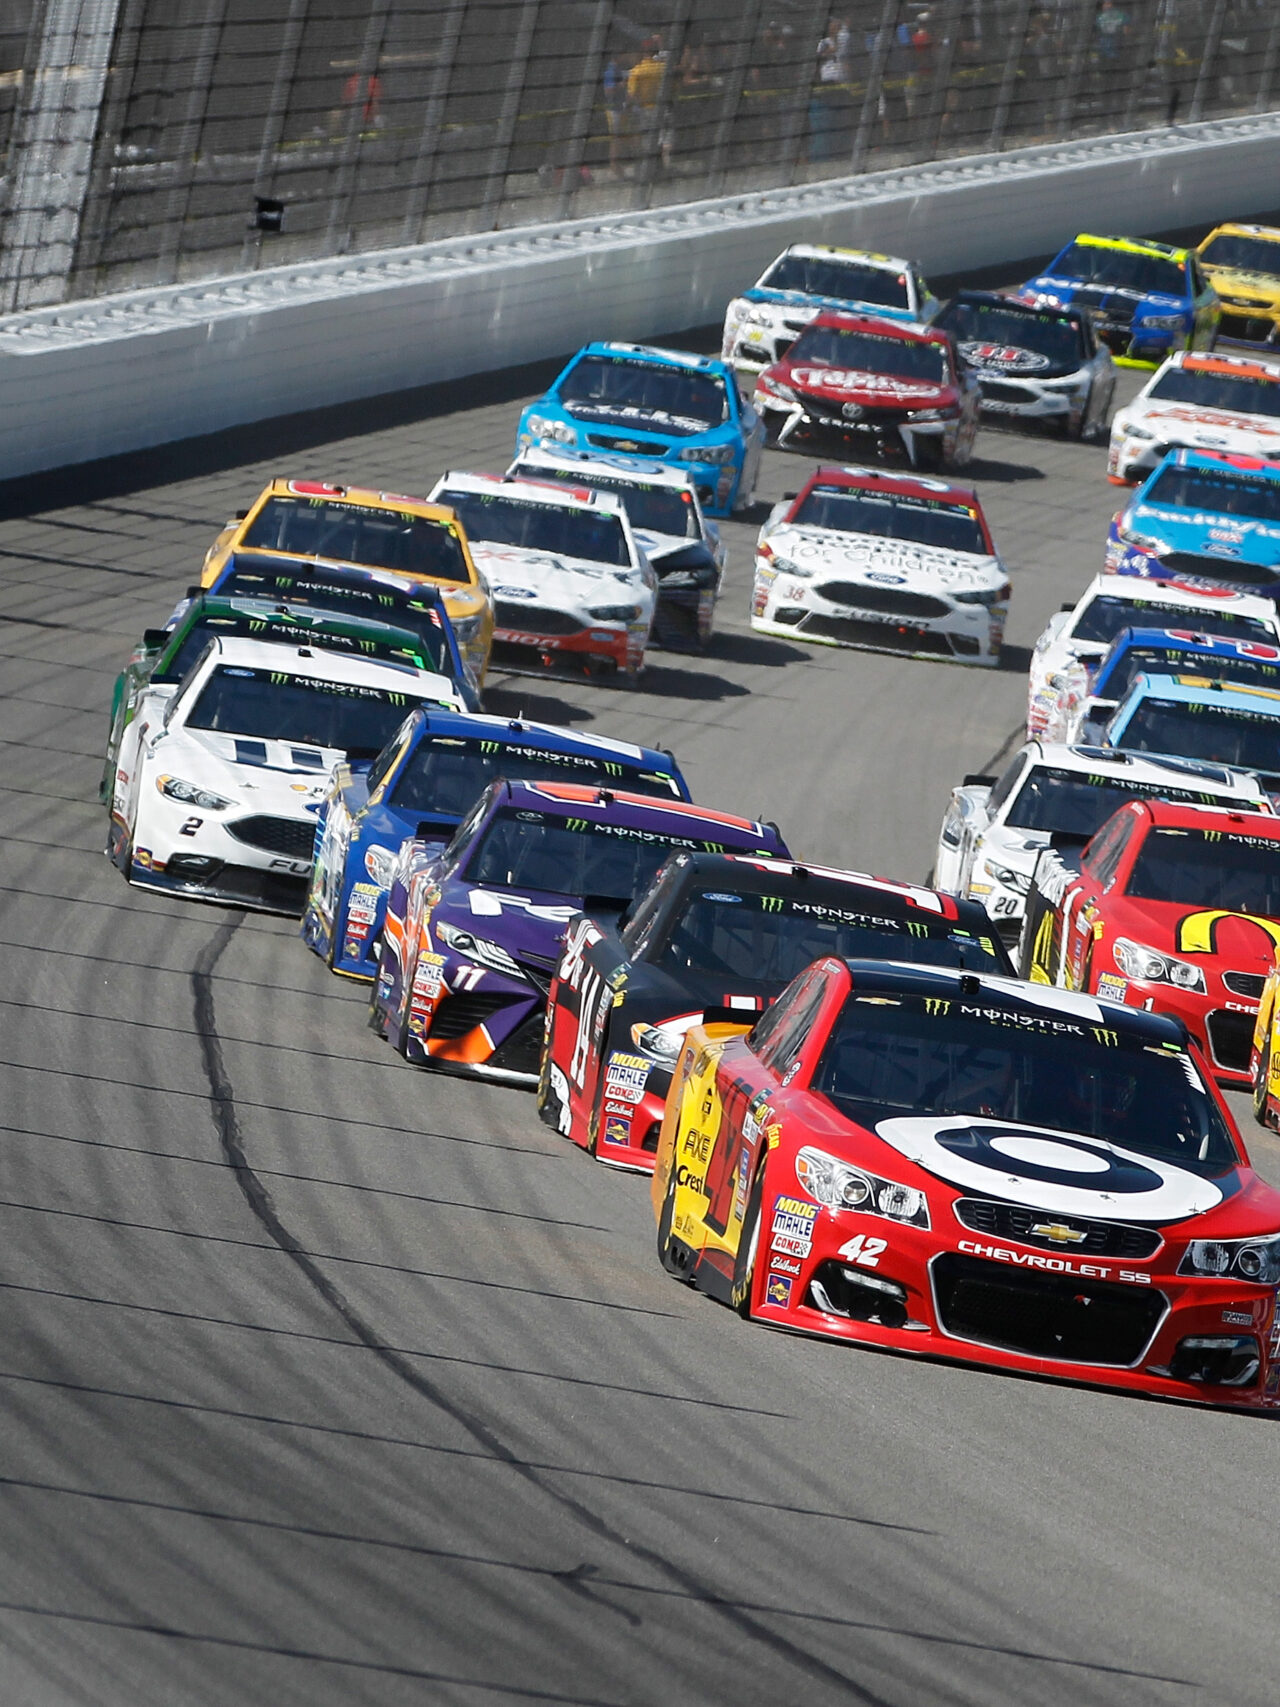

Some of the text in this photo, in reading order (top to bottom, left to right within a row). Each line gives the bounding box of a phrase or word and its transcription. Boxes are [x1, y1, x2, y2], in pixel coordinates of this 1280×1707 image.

[294, 677, 381, 698] MONSTER
[505, 745, 599, 769] MONSTER
[179, 816, 203, 837] 2
[594, 823, 697, 850] MONSTER
[791, 902, 900, 929] MONSTER
[995, 897, 1018, 915] 20
[451, 965, 488, 991] 11
[960, 1005, 1084, 1036] MONSTER
[609, 1052, 652, 1071] MOOG
[608, 1066, 645, 1086] MAHLE
[677, 1164, 704, 1196] Crest
[775, 1197, 819, 1219] MOOG
[774, 1213, 813, 1237] MAHLE
[775, 1236, 801, 1251] COMP
[837, 1234, 888, 1267] 42
[957, 1240, 1152, 1284] CHEVROLET SS
